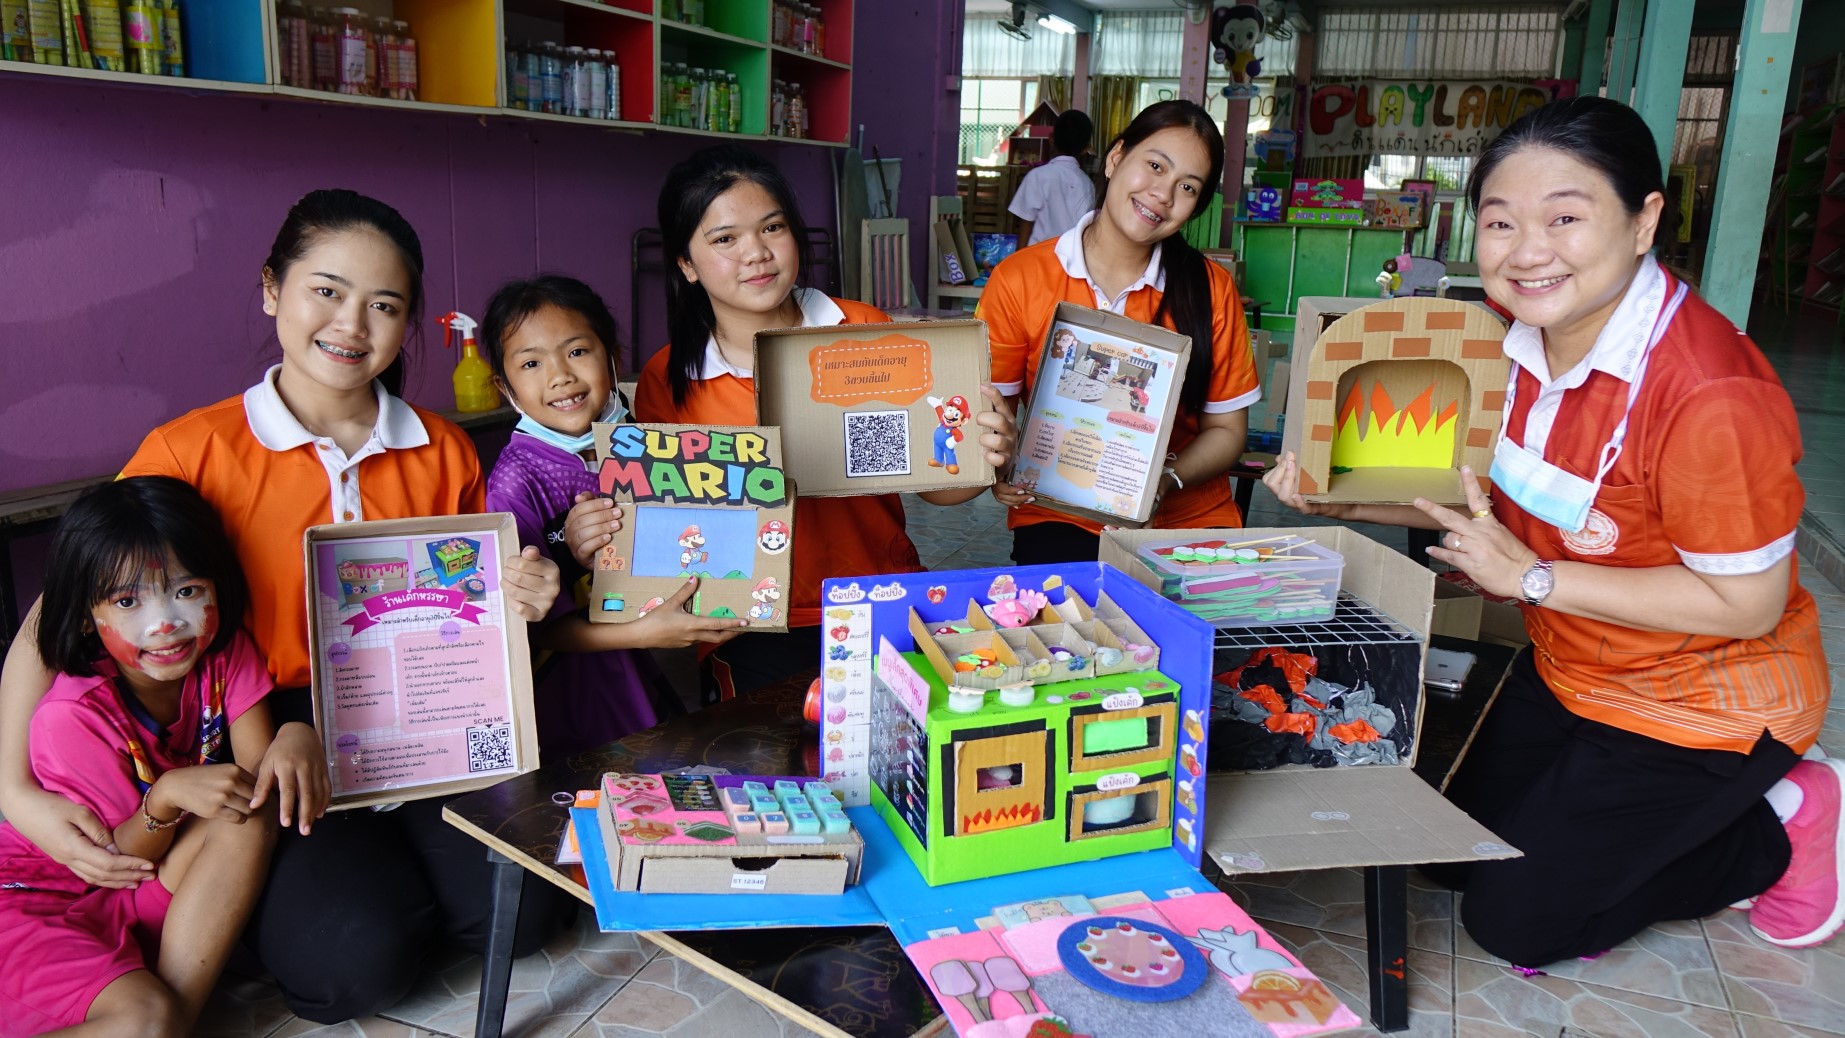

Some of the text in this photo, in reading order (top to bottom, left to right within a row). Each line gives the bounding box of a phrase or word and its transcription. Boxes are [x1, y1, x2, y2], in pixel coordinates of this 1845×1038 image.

[1095, 344, 1117, 357] Super
[824, 355, 908, 371] เหมาะสมกับเด็กอายุ
[844, 371, 891, 385] 3ขวบขึ้นไป
[609, 425, 770, 465] SUPER
[598, 457, 785, 508] MARIO
[473, 715, 504, 725] SCAN ME
